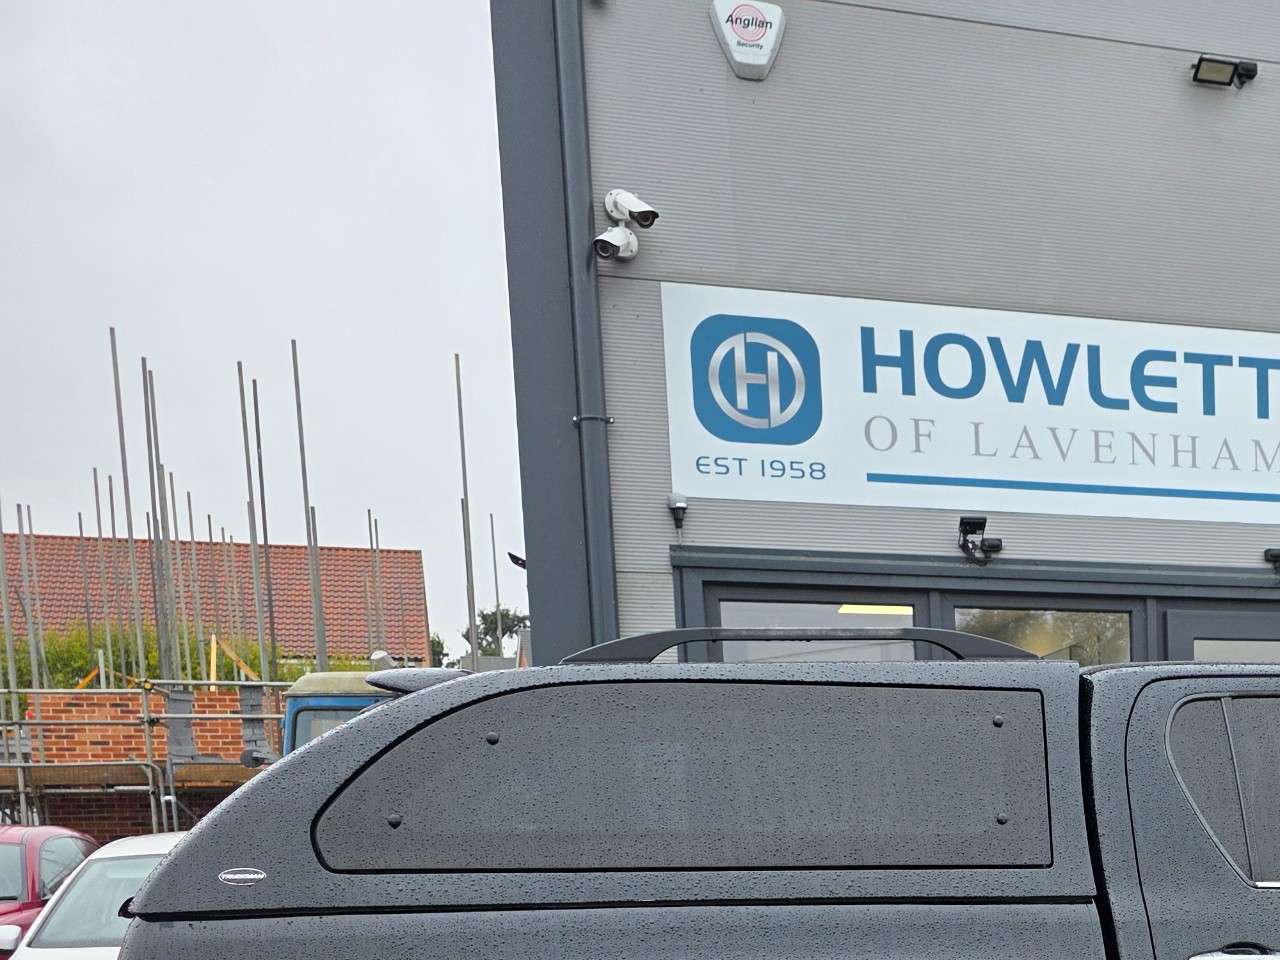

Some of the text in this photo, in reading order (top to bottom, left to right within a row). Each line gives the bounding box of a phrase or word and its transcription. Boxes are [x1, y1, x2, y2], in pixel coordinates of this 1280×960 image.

[725, 14, 773, 29] Anglian
[736, 41, 763, 50] Security
[864, 415, 936, 453] OF
[695, 455, 826, 480] EST 1958
